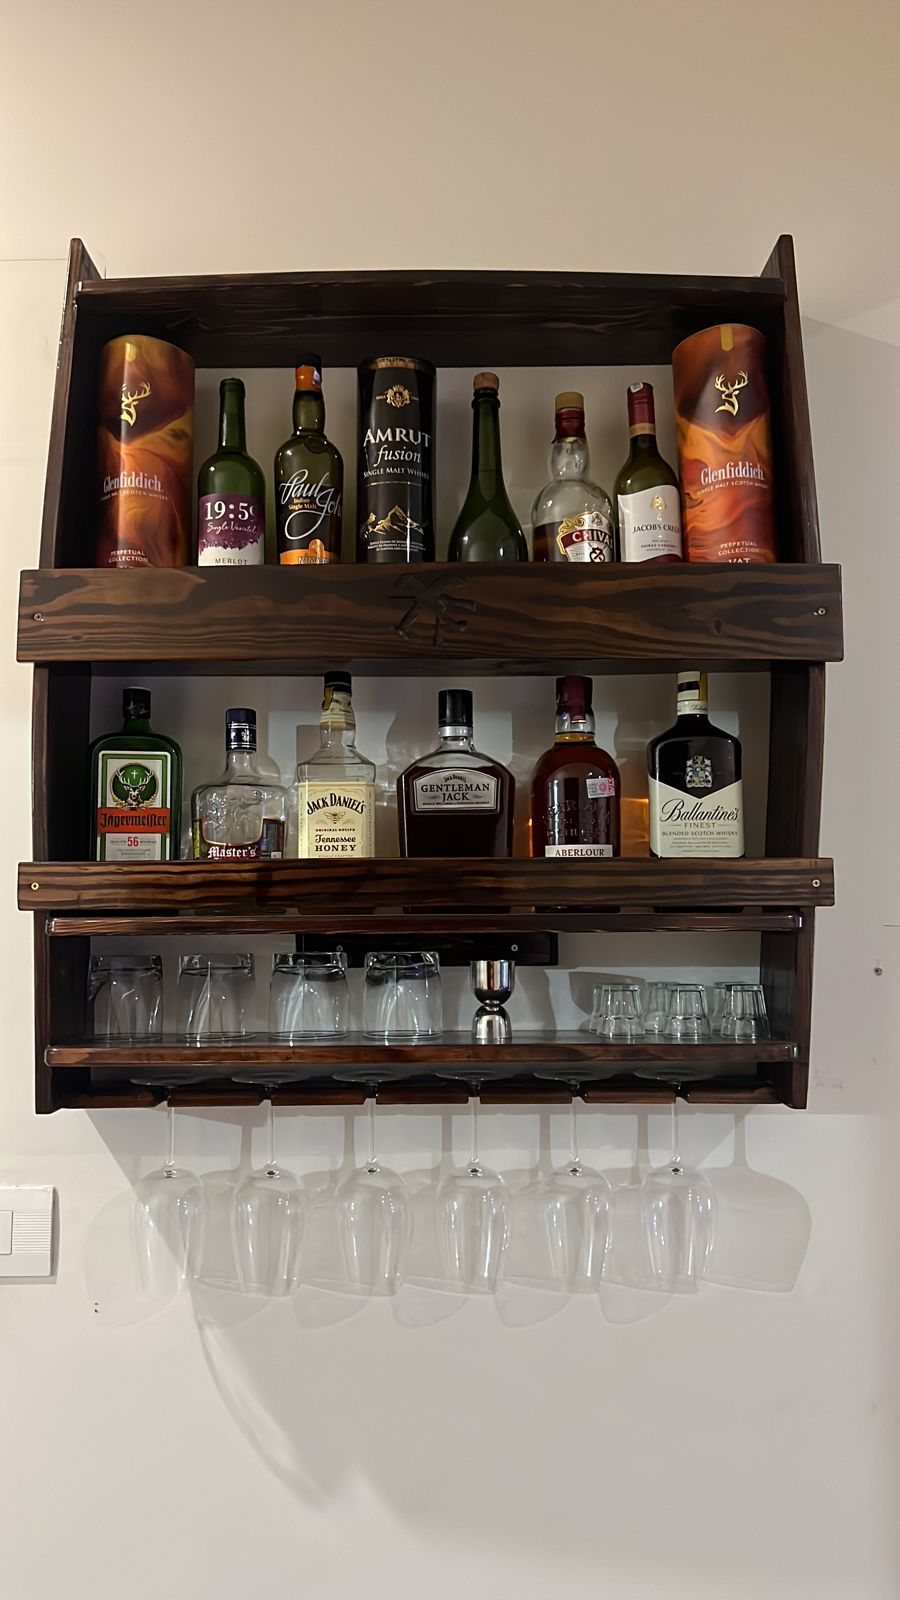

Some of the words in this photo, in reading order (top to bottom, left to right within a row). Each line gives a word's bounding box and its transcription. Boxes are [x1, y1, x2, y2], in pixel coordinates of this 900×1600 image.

[363, 427, 431, 447] AMRUT
[373, 444, 421, 467] fusion
[364, 467, 384, 478] SINGLE
[386, 466, 405, 474] MALT
[701, 462, 764, 486] Glenfiddich
[103, 471, 161, 493] Glenfiddich
[279, 468, 330, 504] Paul
[720, 541, 757, 549] PERPETUAL
[718, 547, 760, 556] COLLECTION
[421, 783, 490, 792] GENTLEMAN
[442, 792, 469, 802] JACK
[307, 796, 329, 815] JACK
[329, 793, 366, 815] DANIEL'S
[660, 798, 740, 822] Ballantine's
[127, 837, 139, 847] 56
[315, 834, 356, 843] Tennessee
[208, 846, 256, 858] Master's
[555, 848, 605, 857] ABERLOUR
